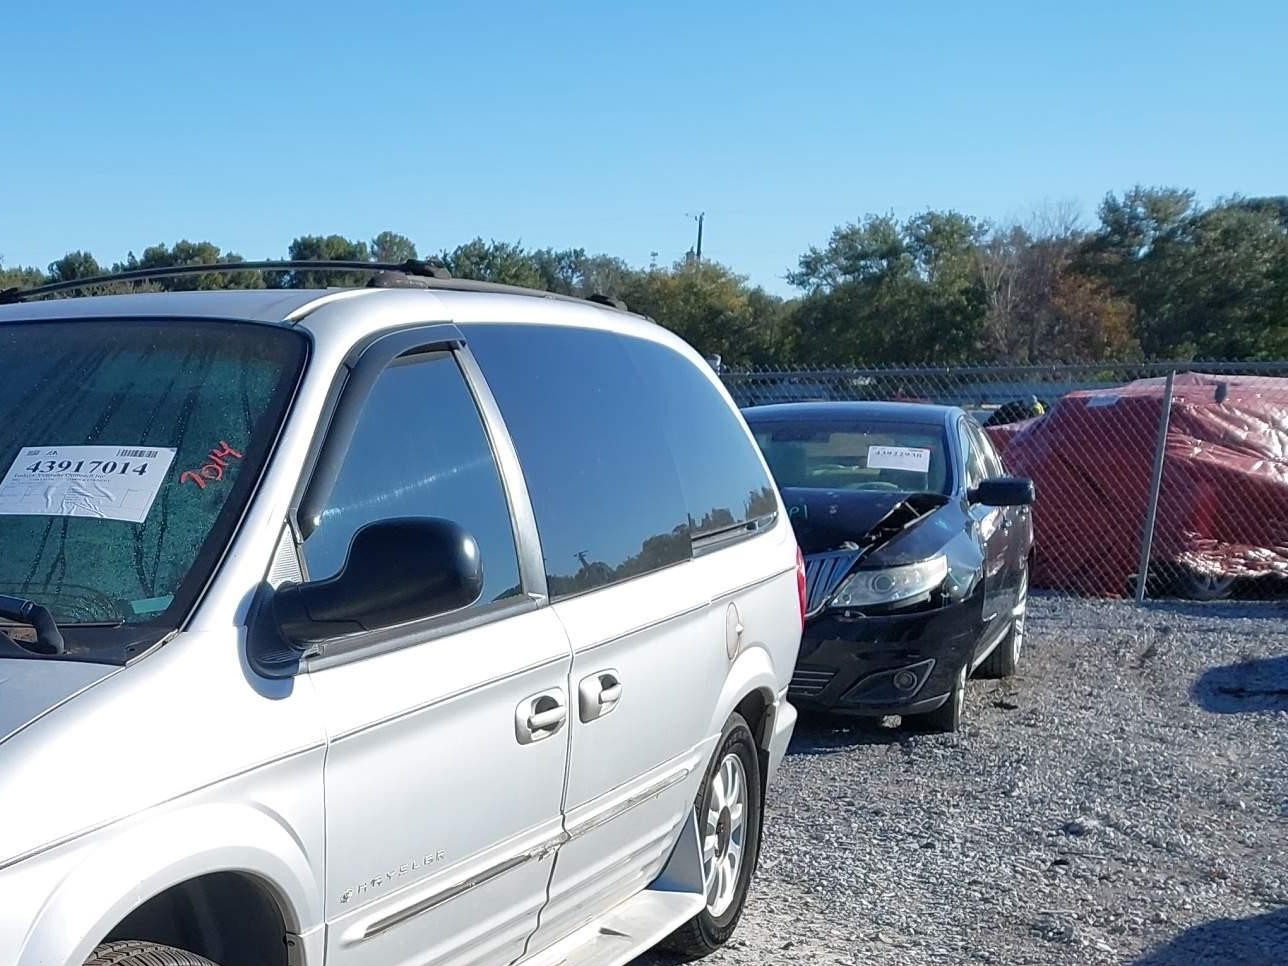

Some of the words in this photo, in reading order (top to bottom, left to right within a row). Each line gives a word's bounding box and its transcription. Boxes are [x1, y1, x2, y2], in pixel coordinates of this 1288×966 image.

[25, 459, 149, 476] 43917014
[180, 440, 243, 489] 7014
[339, 849, 445, 904] CHRYSLER
